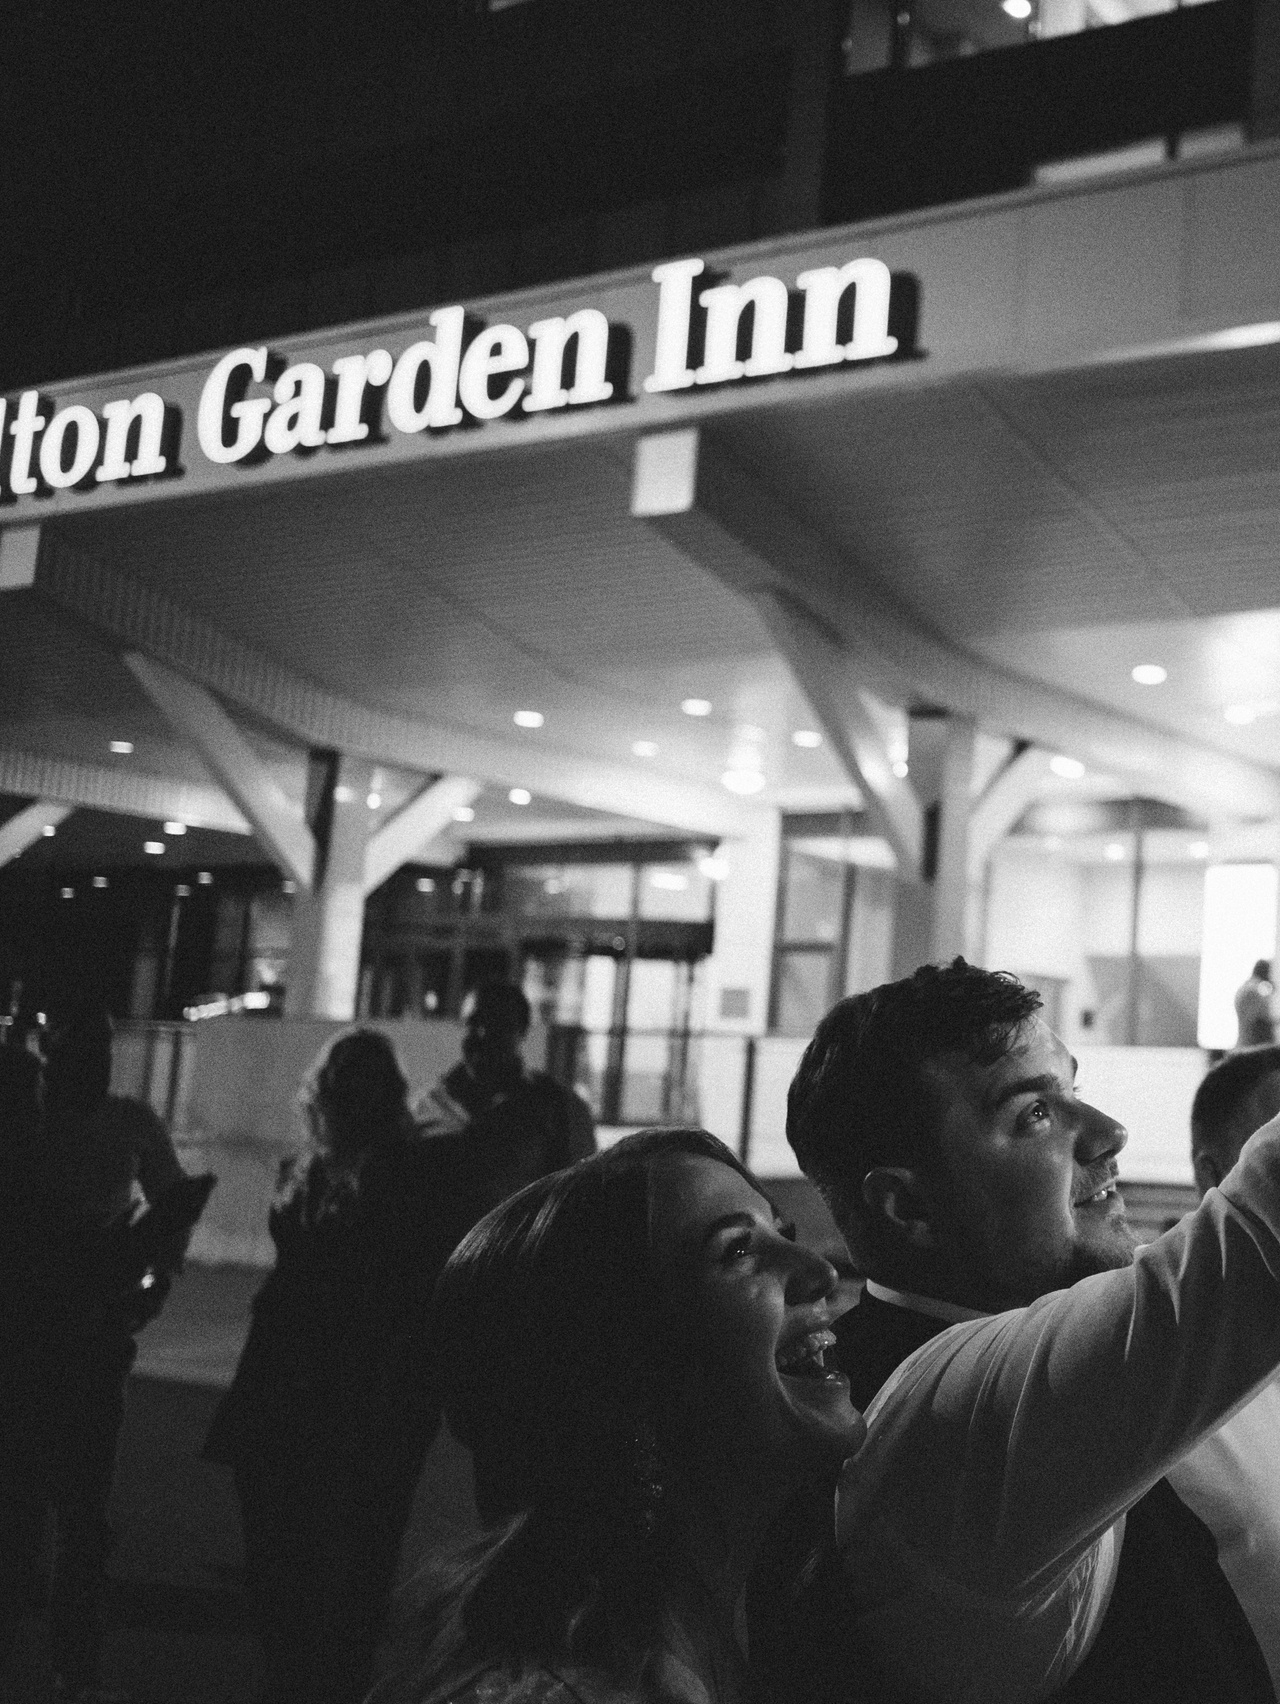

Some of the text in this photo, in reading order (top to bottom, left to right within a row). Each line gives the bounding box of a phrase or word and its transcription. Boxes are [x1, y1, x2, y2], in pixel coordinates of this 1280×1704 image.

[0, 257, 898, 494] ton Garden Inn
